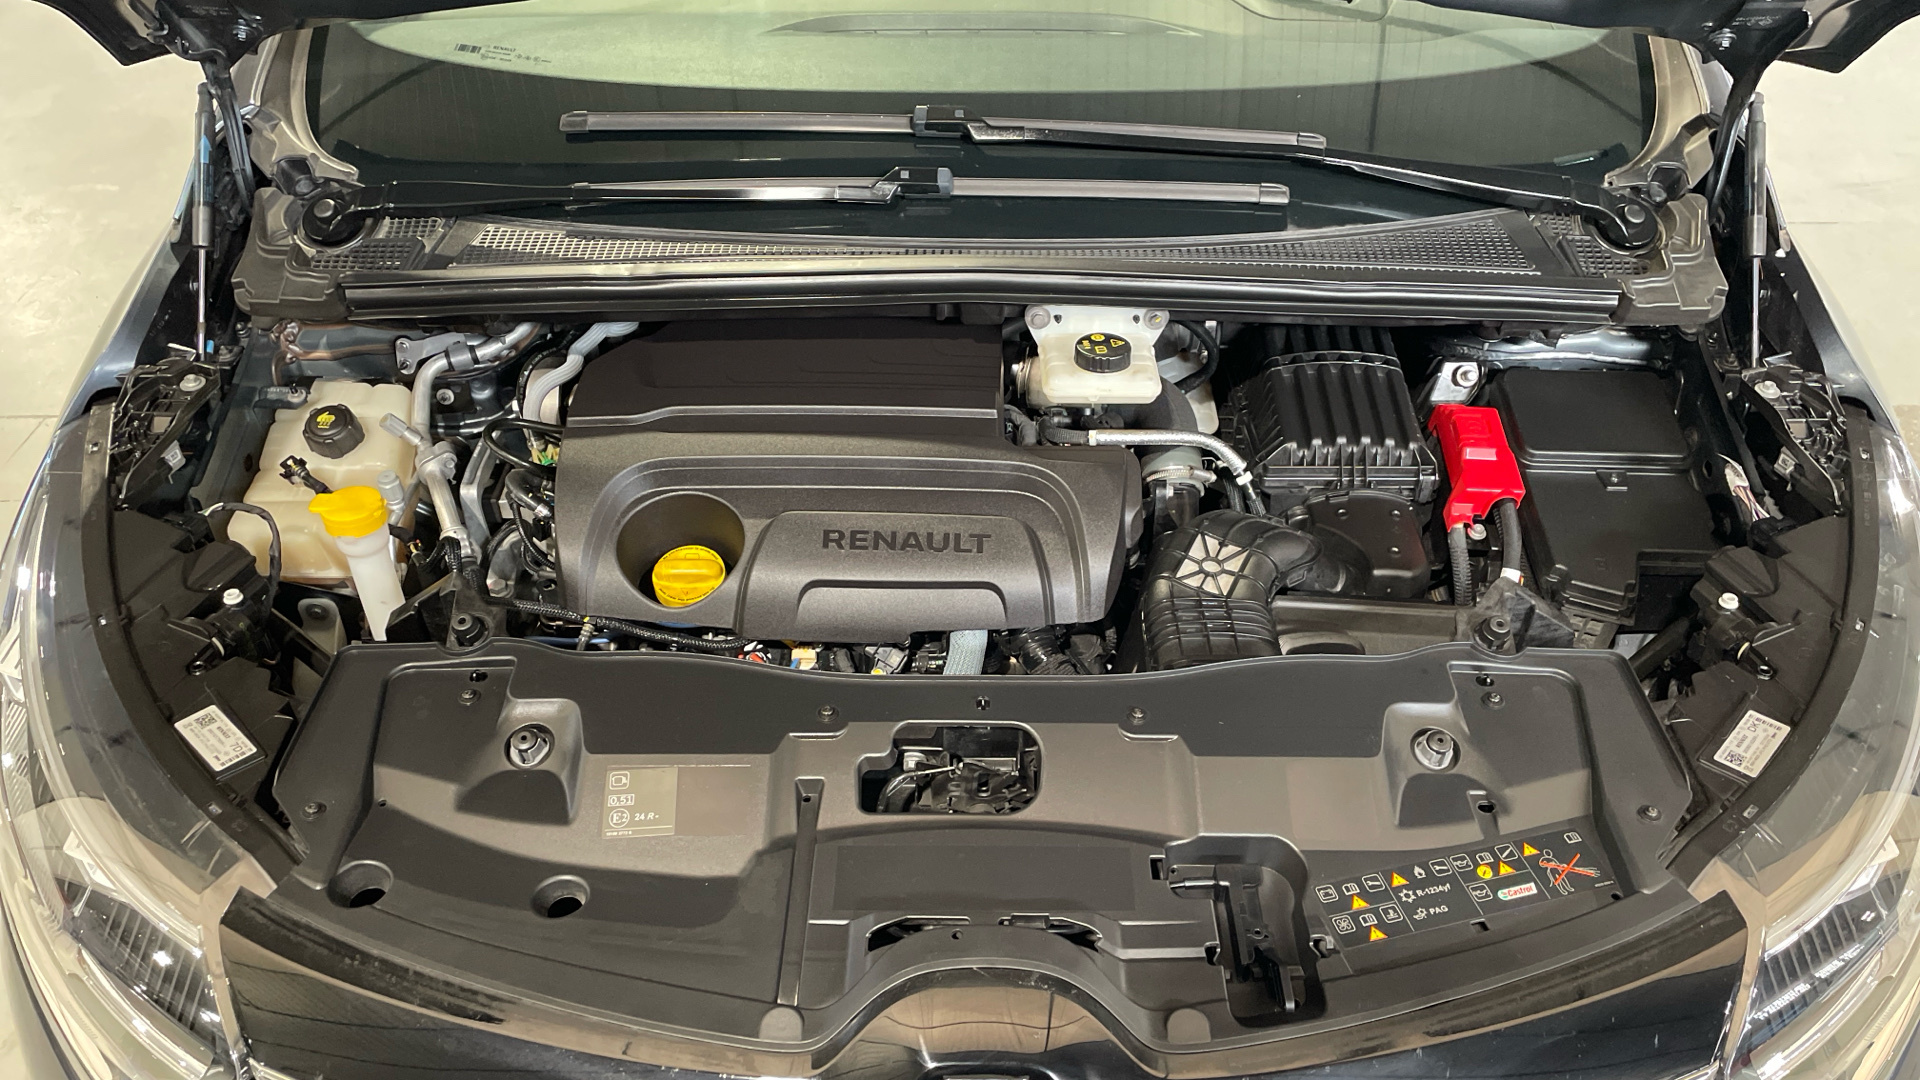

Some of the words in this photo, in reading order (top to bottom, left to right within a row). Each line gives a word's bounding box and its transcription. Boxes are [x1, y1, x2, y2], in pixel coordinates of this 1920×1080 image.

[822, 529, 992, 554] RENAULT
[1747, 720, 1760, 732] DK
[610, 796, 632, 806] 0,51
[1416, 882, 1451, 897] R-1234yf
[1507, 885, 1534, 897] Castrol
[1429, 905, 1448, 916] PAG
